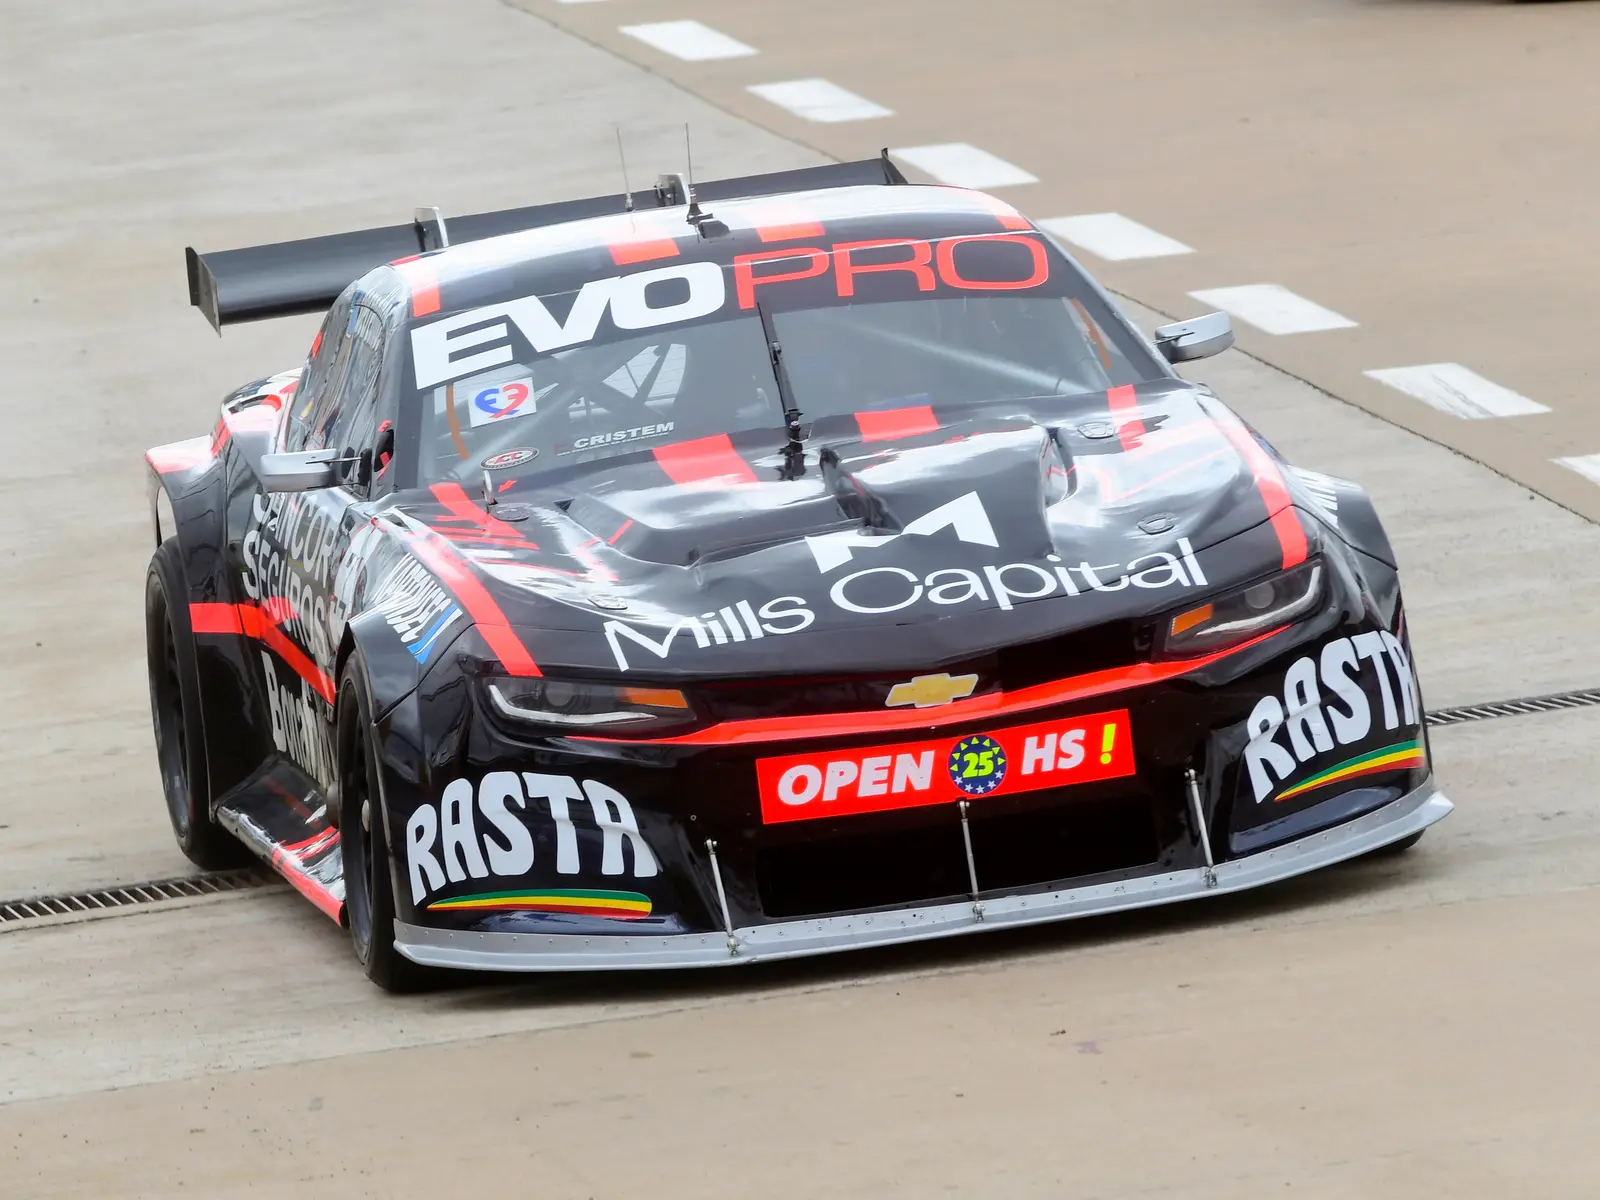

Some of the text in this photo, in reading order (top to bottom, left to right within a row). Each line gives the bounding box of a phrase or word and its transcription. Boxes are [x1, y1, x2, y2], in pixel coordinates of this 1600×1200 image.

[574, 421, 674, 448] CRISTEM
[242, 530, 329, 667] SEGUROS
[603, 537, 1209, 672] Mills Capital
[777, 750, 935, 805] OPEN
[962, 751, 995, 779] 25
[1021, 728, 1087, 776] HS
[1244, 630, 1420, 803] RASTA
[406, 771, 658, 906] RASTA
